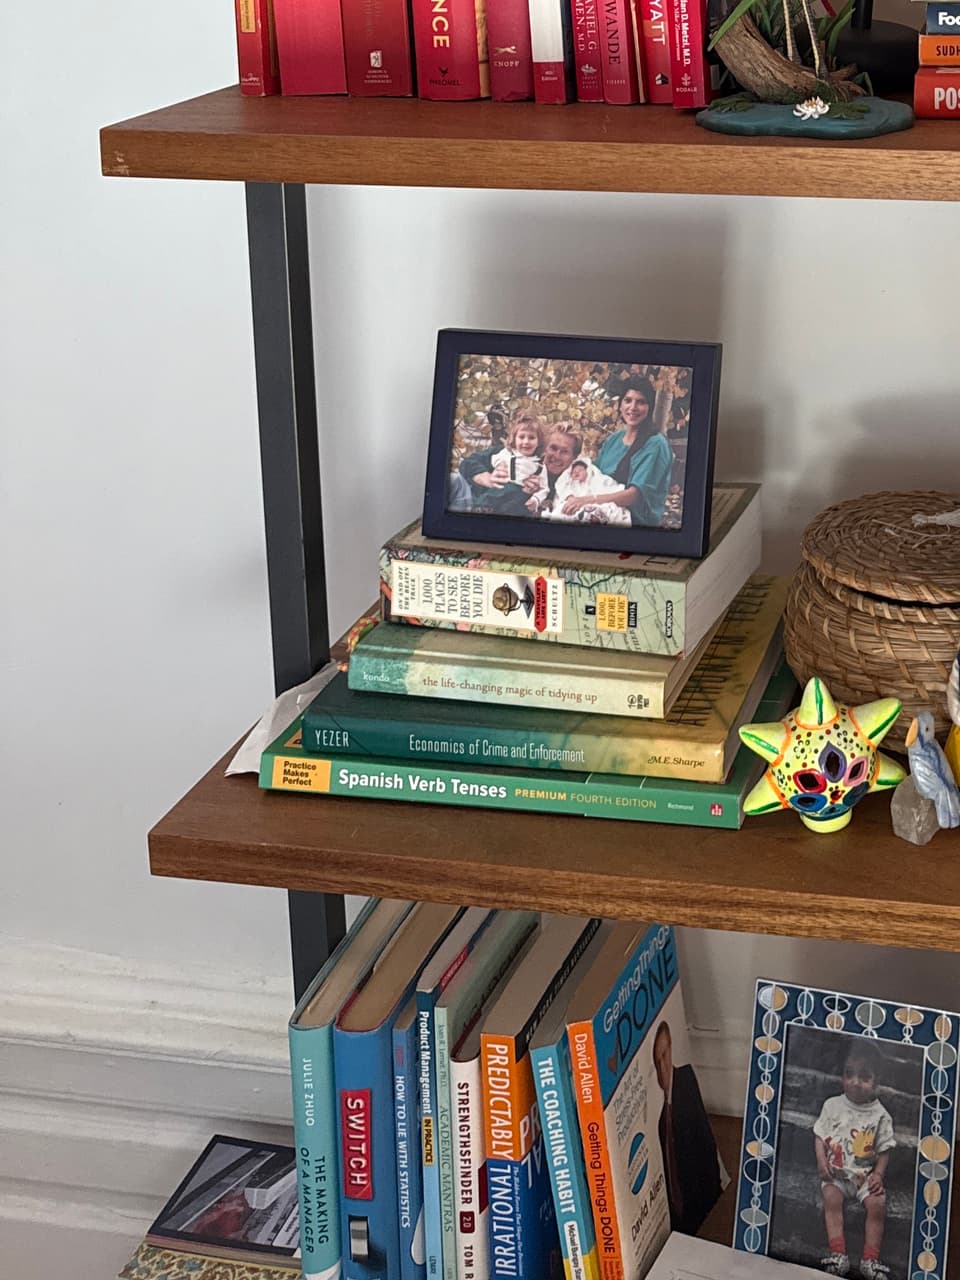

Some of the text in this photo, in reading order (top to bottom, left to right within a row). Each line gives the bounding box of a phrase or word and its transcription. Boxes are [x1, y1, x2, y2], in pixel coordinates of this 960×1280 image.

[423, 678, 598, 704] the life-changing magic of tidying up
[282, 777, 312, 787] Perfect
[283, 760, 317, 770] Practice
[283, 769, 310, 777] Makes
[315, 730, 584, 762] YEZER Economics of Crime and Enforcement
[339, 769, 657, 808] Spanish Verb Tenses PREMIUM FOURTH EDITION
[345, 1097, 368, 1186] SWITCH
[458, 1082, 472, 1204] STRENGTHSFINDER
[487, 1043, 515, 1163] PREDICTABLY
[538, 1057, 575, 1214] THE COACHING HABIT
[574, 1032, 616, 1254] David Allen Getting Things DONE
[396, 1075, 411, 1228] HOW TO LIE WITH STATISTICS
[490, 1165, 516, 1277] IRRATIONAL
